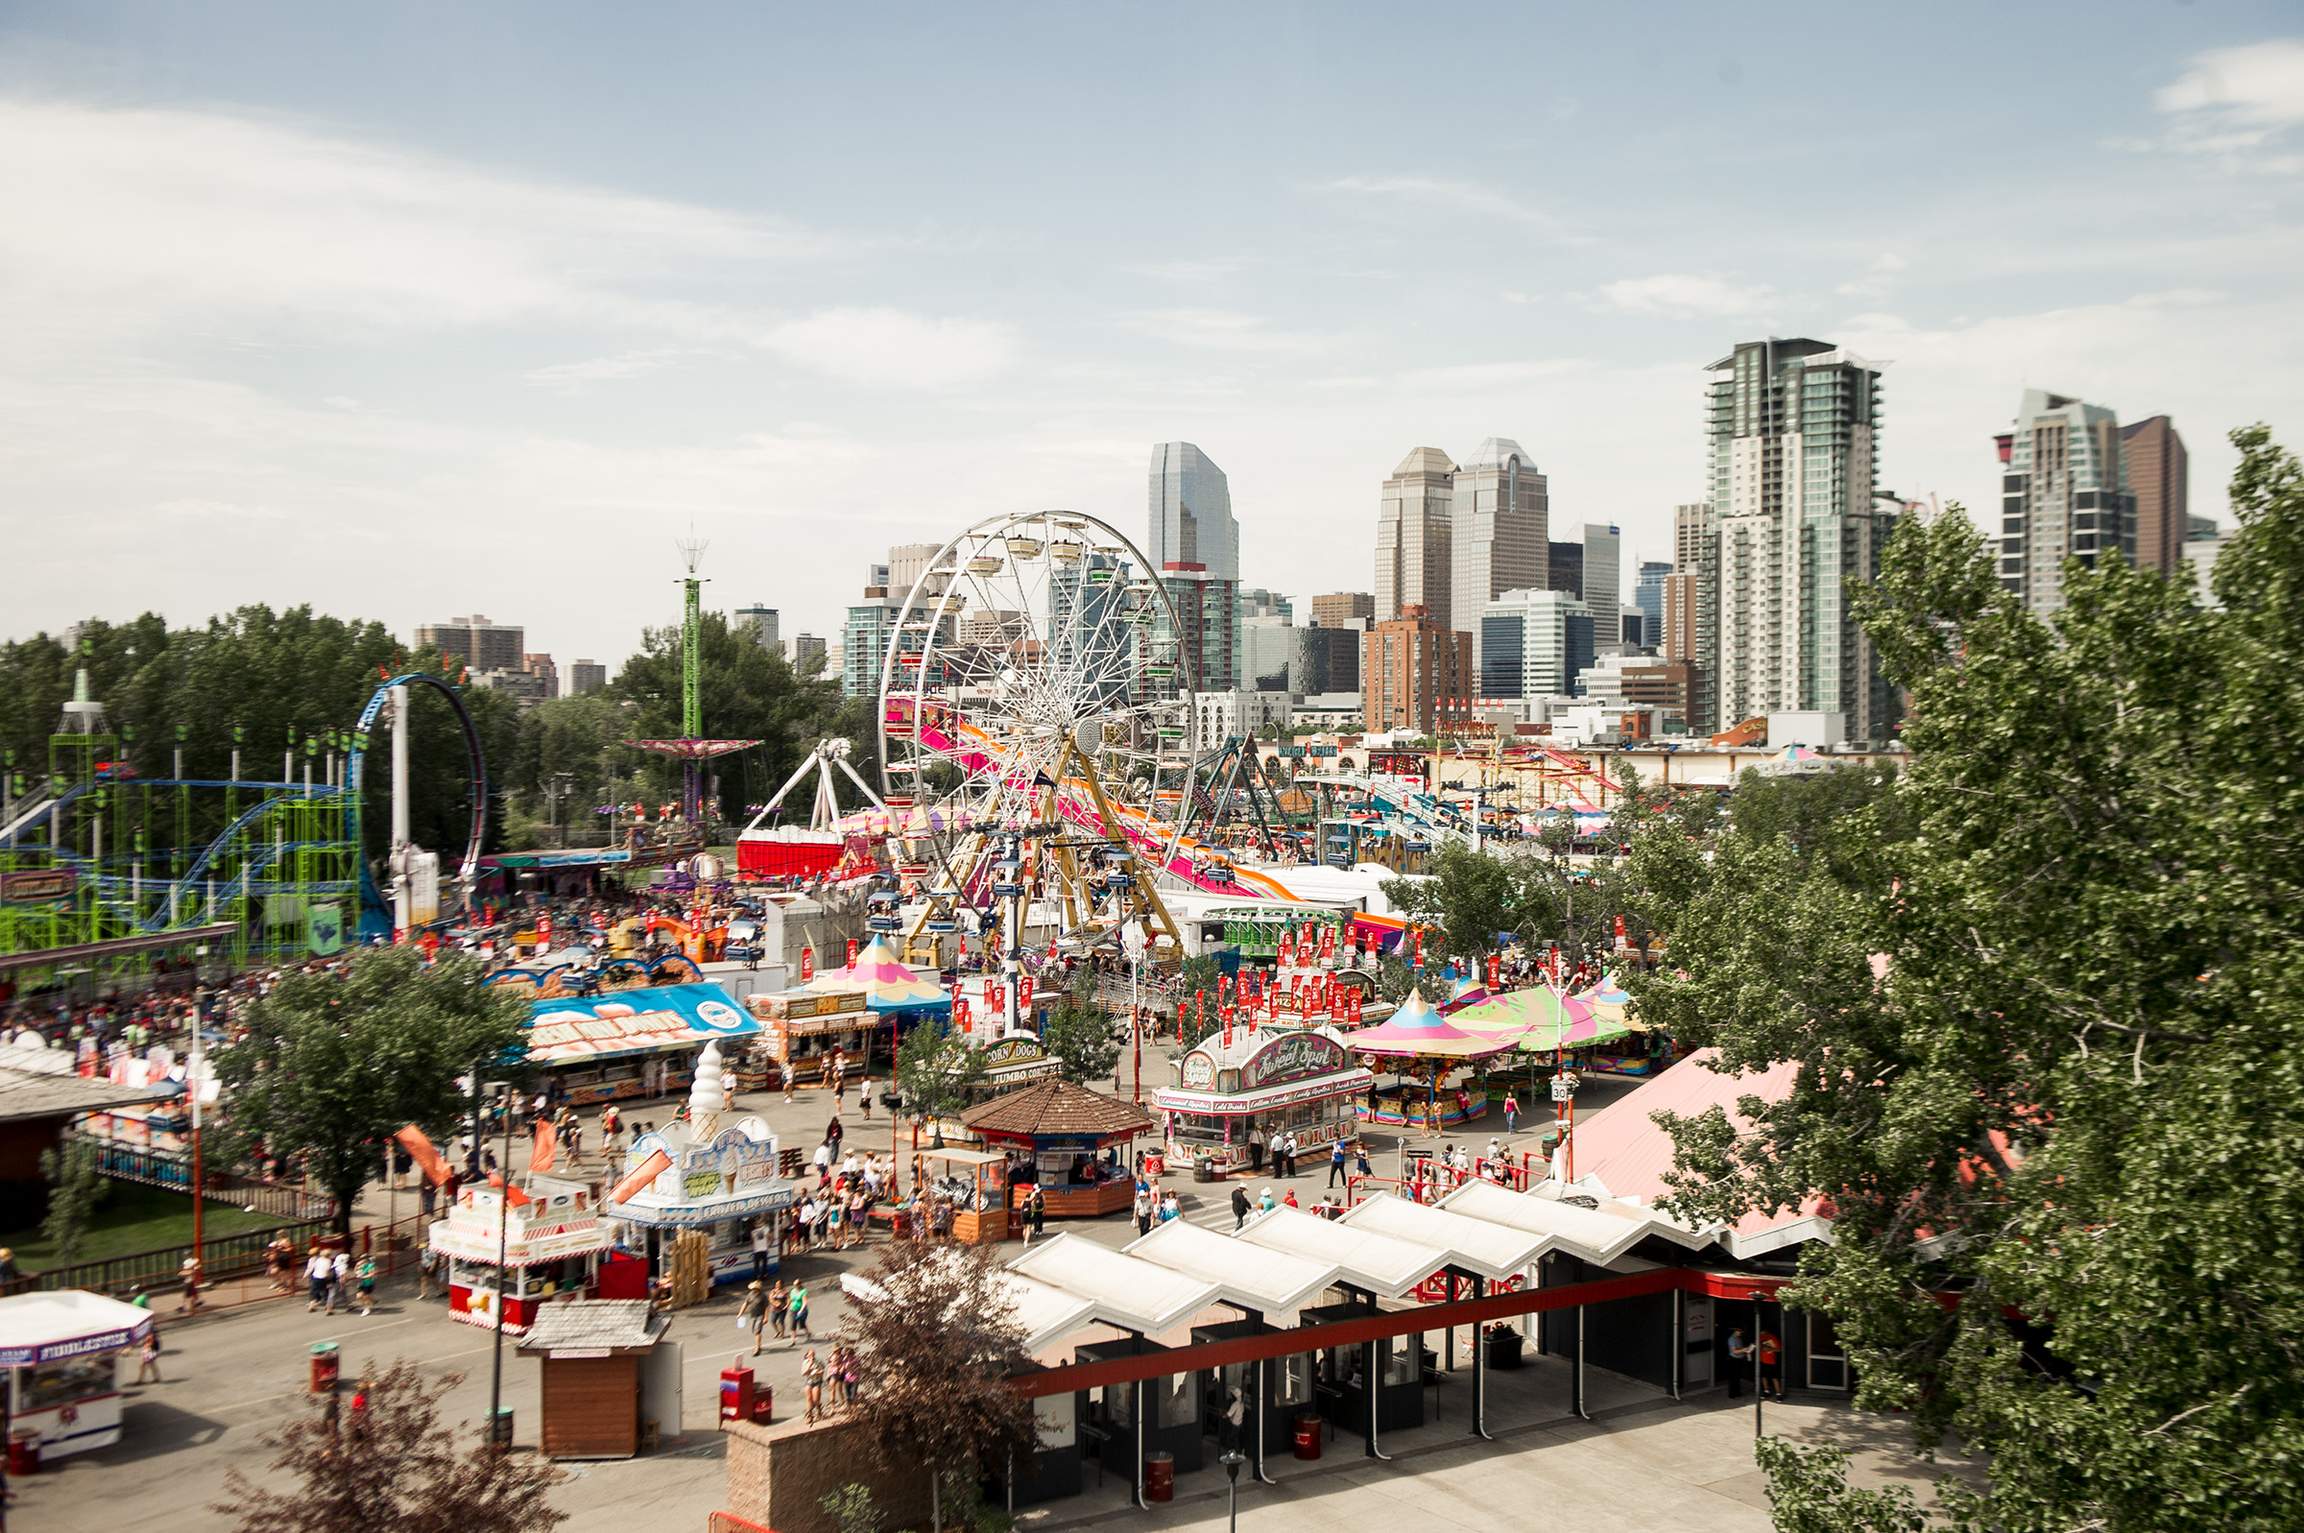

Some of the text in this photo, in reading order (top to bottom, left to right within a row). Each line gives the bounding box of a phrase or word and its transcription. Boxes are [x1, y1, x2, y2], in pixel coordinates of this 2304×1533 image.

[986, 1045, 1037, 1063] CORN DOGS
[1257, 1042, 1299, 1080] Sweet
[1299, 1041, 1331, 1068] Spot
[993, 1070, 1026, 1084] JUMBO
[1554, 1089, 1565, 1098] 30
